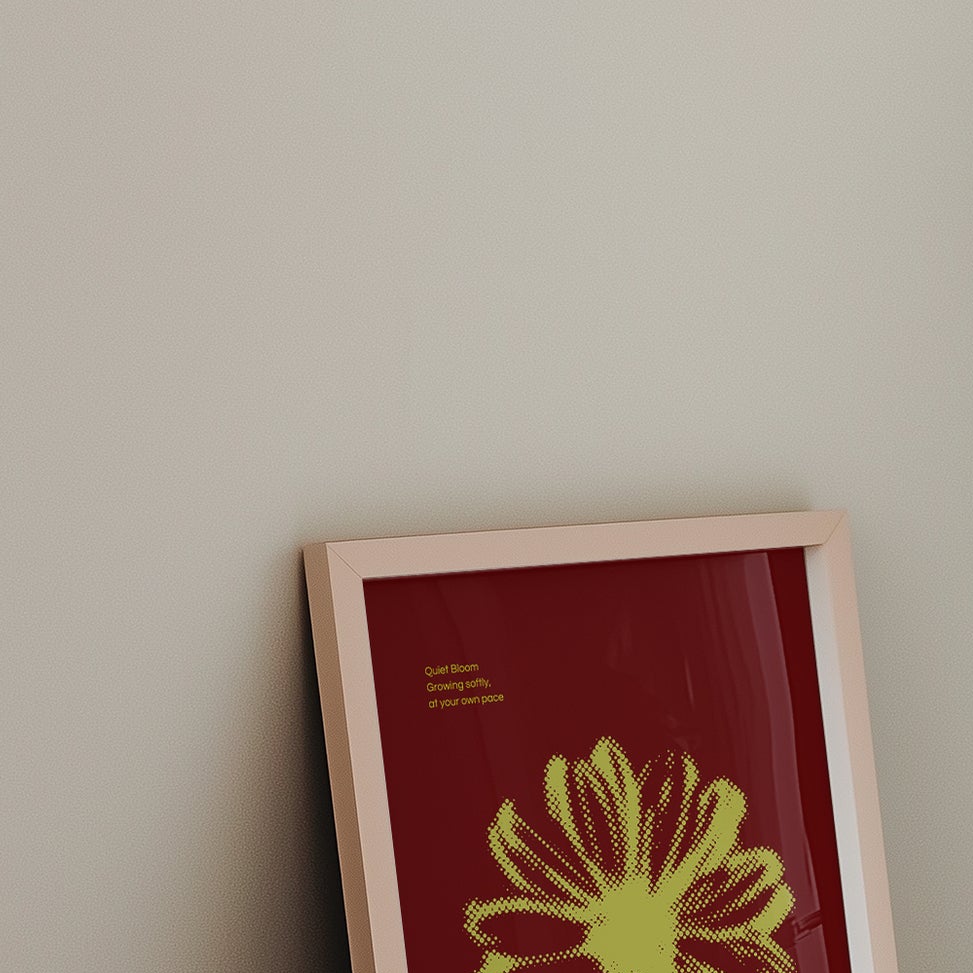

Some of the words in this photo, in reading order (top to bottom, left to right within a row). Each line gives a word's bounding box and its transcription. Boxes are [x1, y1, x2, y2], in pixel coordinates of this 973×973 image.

[424, 665, 448, 677] Quiet
[450, 663, 479, 674] Bloom
[426, 680, 464, 692] Growing
[465, 677, 491, 689] softly,
[428, 698, 438, 708] at
[439, 697, 459, 709] your
[461, 696, 480, 705] own
[481, 694, 504, 705] pace
